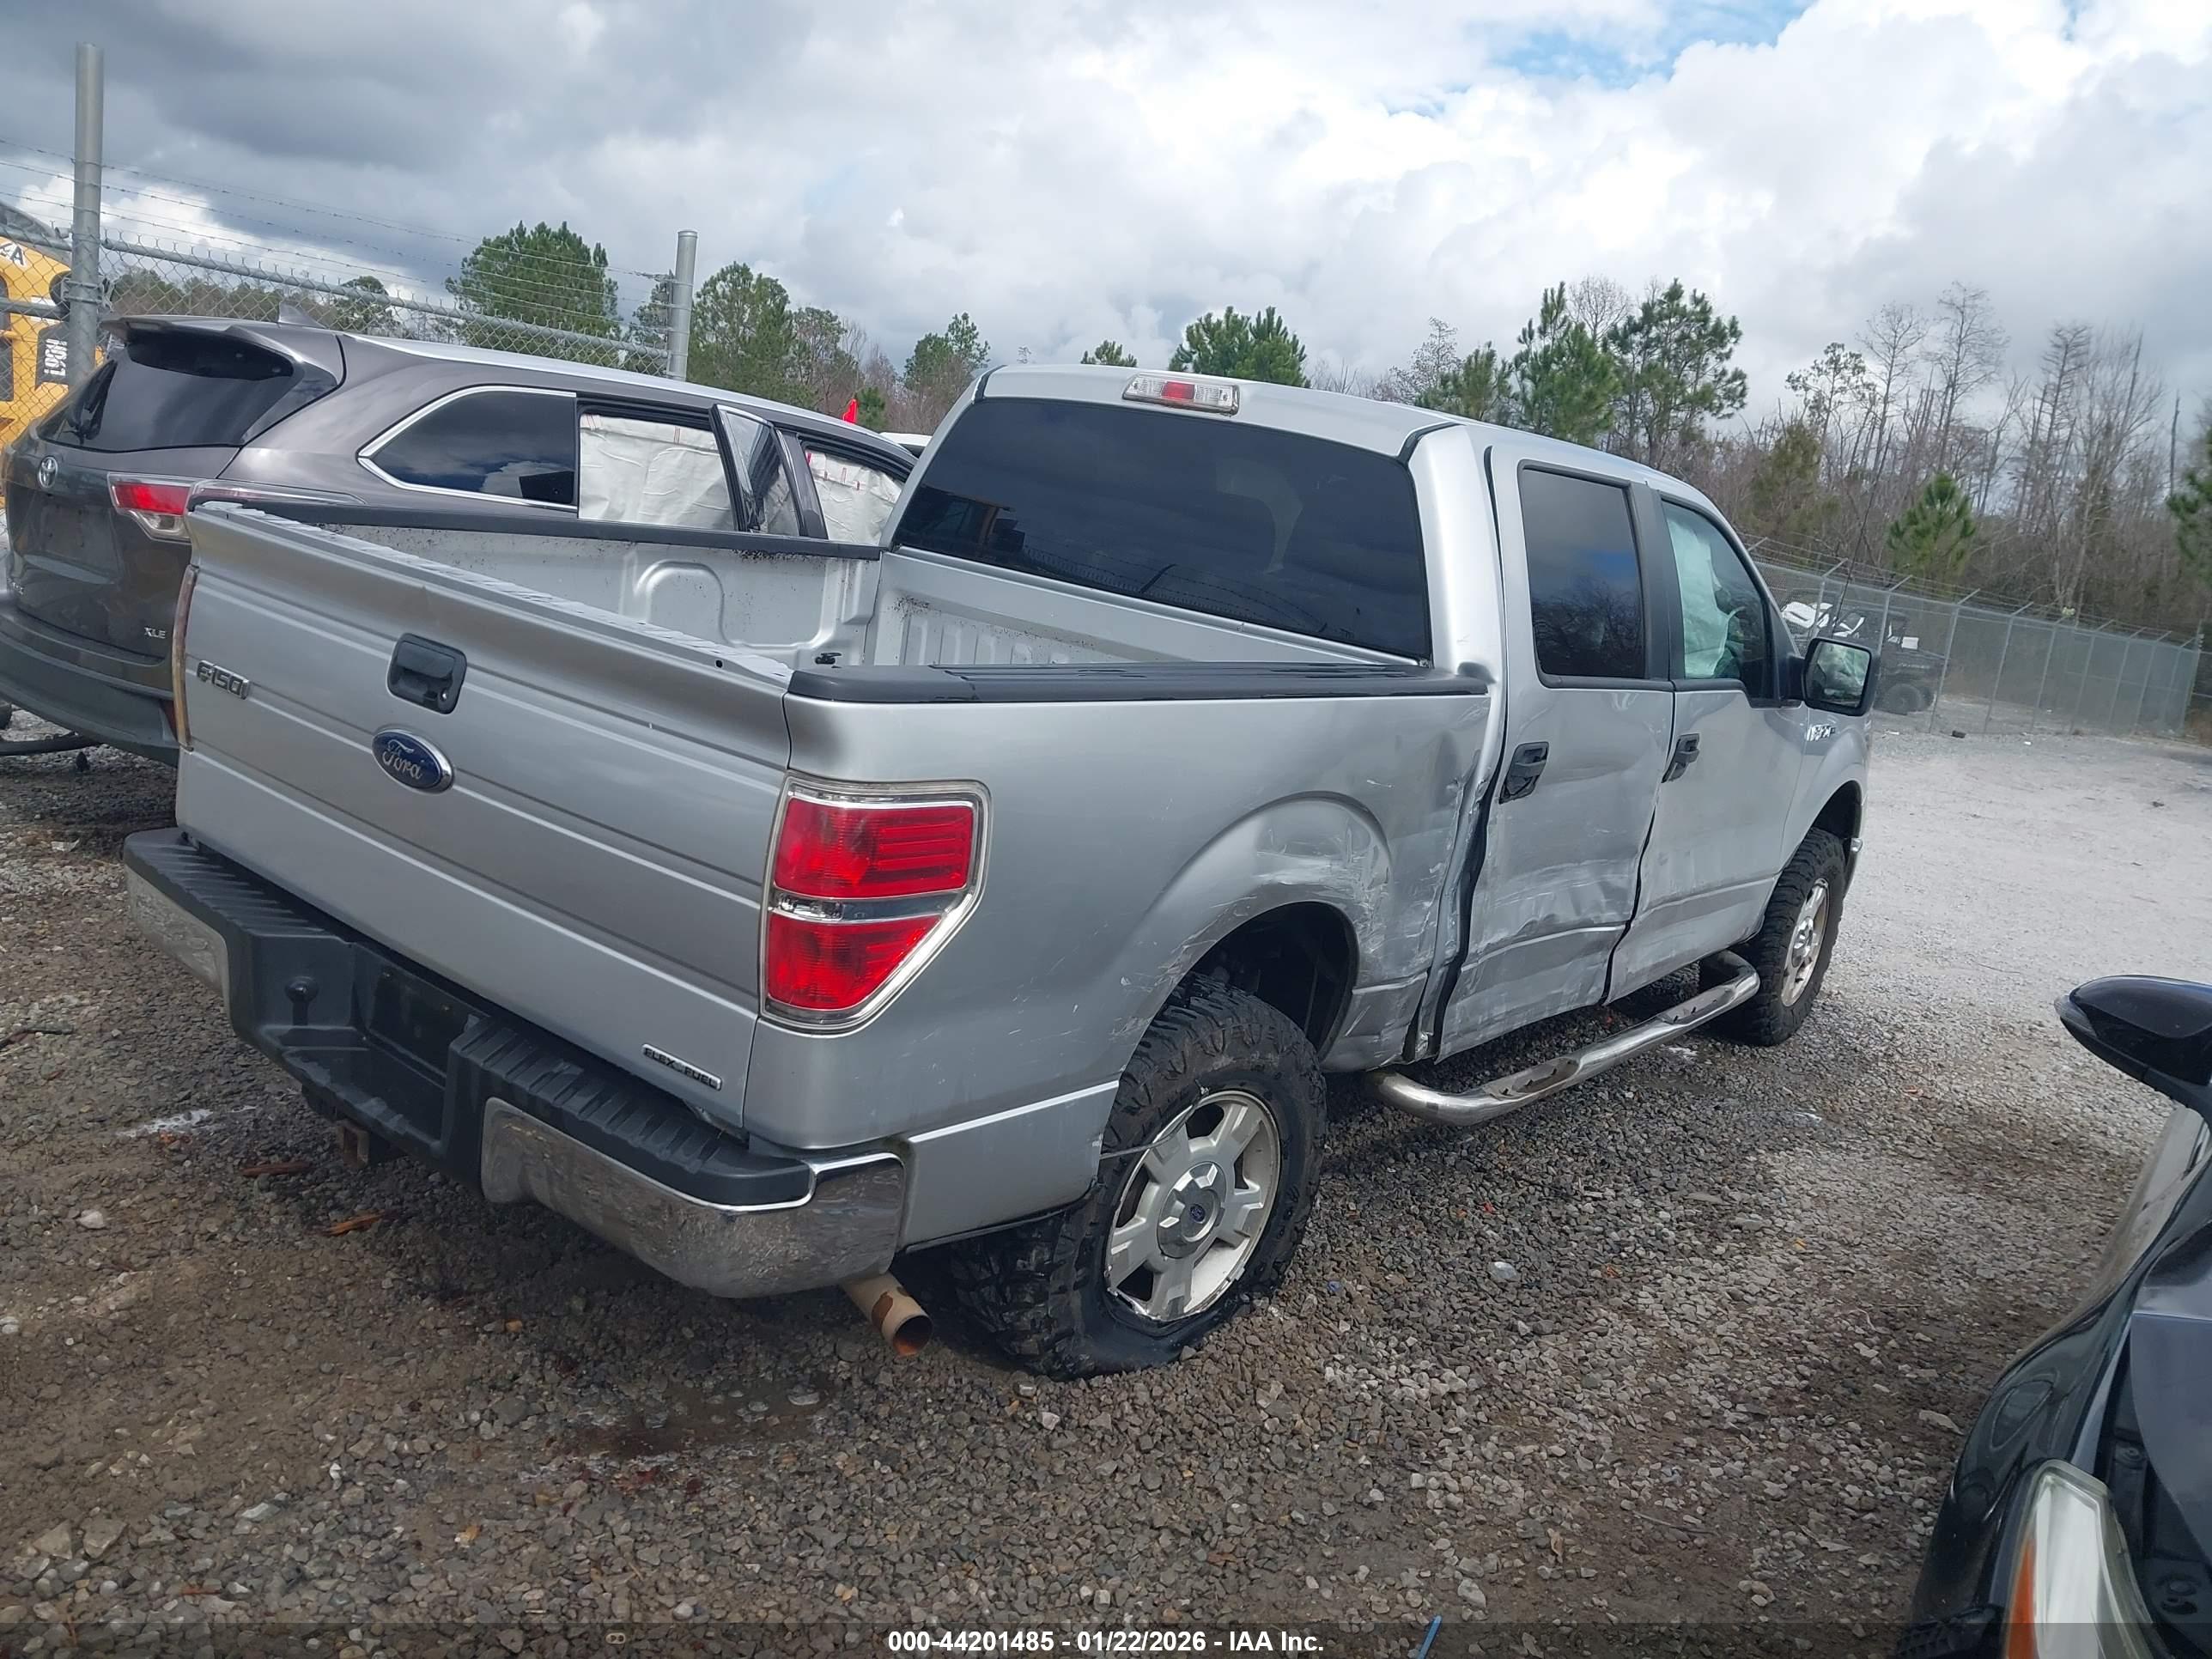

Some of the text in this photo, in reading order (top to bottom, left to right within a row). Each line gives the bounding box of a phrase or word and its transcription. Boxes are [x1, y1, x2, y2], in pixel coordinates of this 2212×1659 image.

[144, 627, 166, 639] XLE
[382, 739, 423, 780] Ford
[684, 1066, 719, 1090] FUEL
